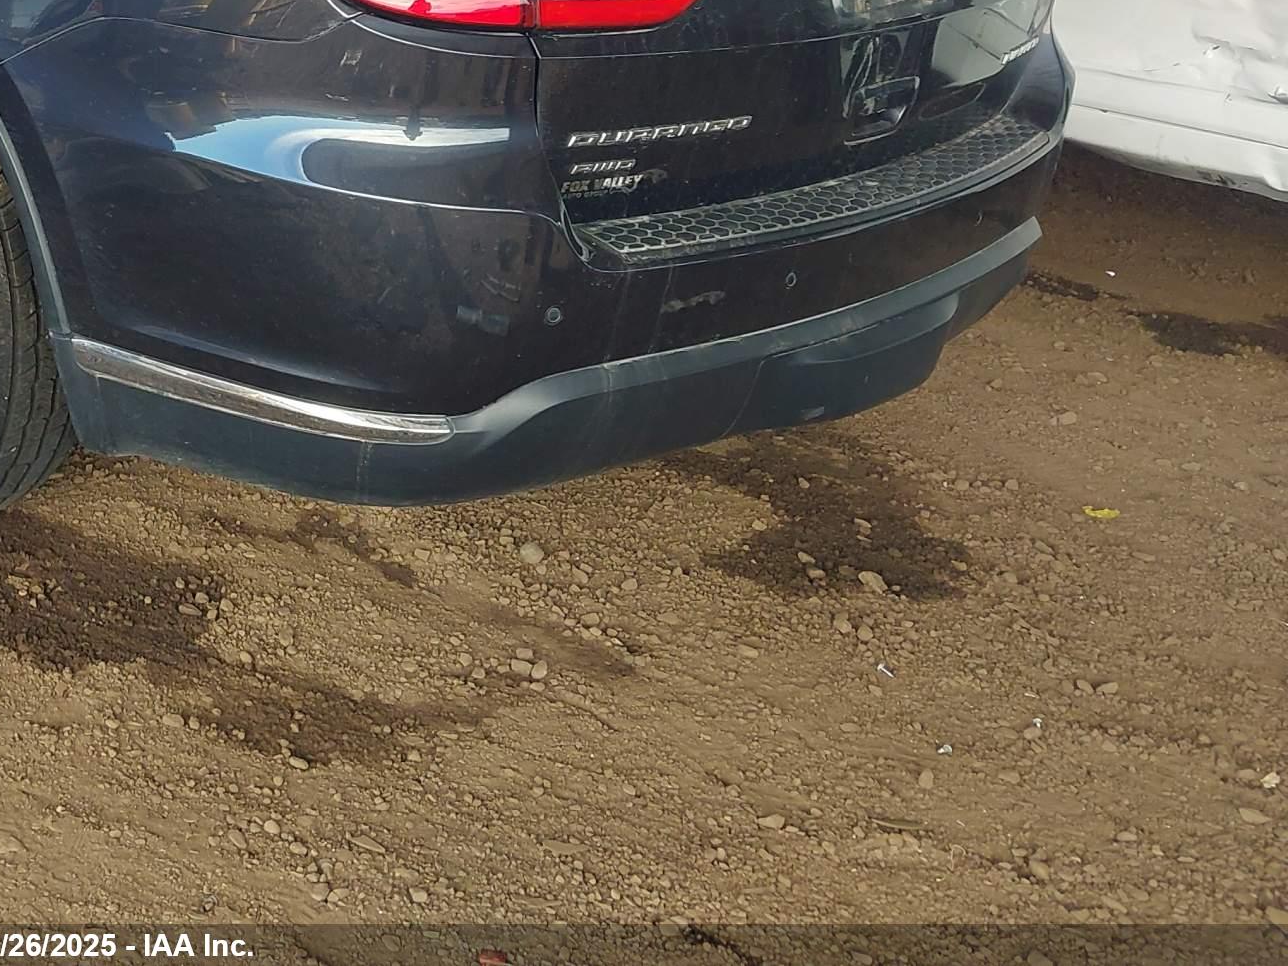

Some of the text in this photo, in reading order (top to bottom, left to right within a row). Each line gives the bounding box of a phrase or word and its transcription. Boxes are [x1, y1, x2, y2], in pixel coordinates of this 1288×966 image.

[567, 115, 753, 147] DURANGO
[570, 158, 637, 175] AWD
[561, 174, 644, 193] FOX VALLEY
